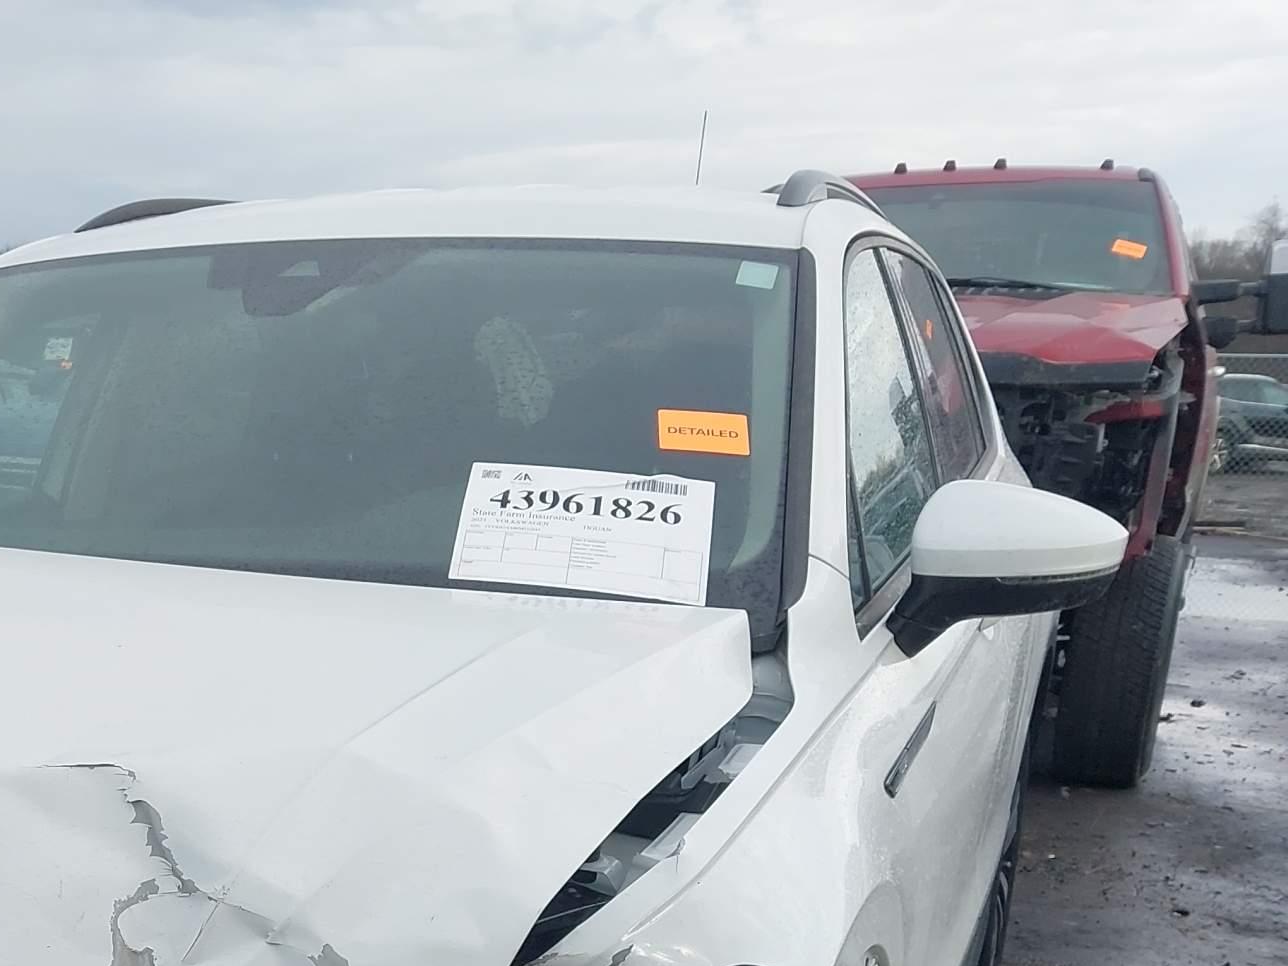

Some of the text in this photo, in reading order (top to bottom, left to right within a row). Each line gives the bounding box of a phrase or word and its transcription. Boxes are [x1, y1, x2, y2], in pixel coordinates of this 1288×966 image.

[667, 425, 739, 439] DETAILED
[472, 507, 576, 522] State Farm Insurance
[489, 488, 683, 526] 43961826
